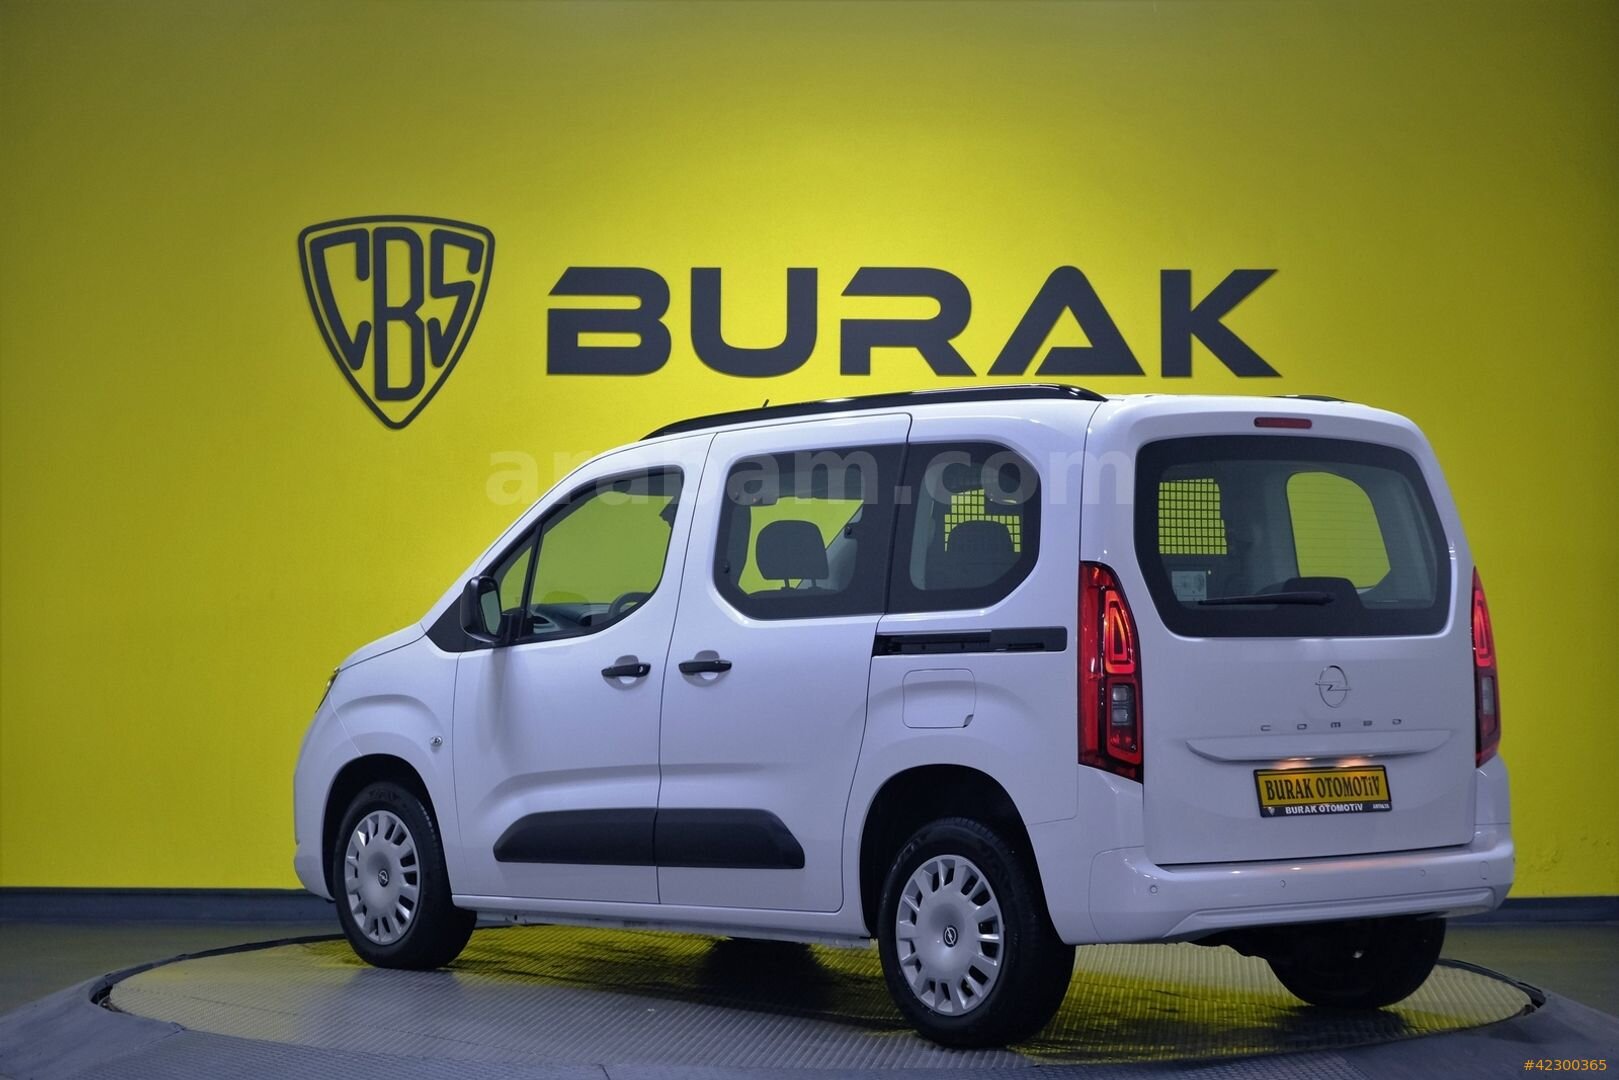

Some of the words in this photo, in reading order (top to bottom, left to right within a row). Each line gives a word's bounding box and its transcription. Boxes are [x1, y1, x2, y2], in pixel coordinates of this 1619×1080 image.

[309, 226, 486, 402] CBS
[546, 265, 1282, 379] BURAK
[1260, 718, 1402, 732] COMBO
[1264, 778, 1314, 801] BURAK
[1285, 805, 1317, 815] BURAK
